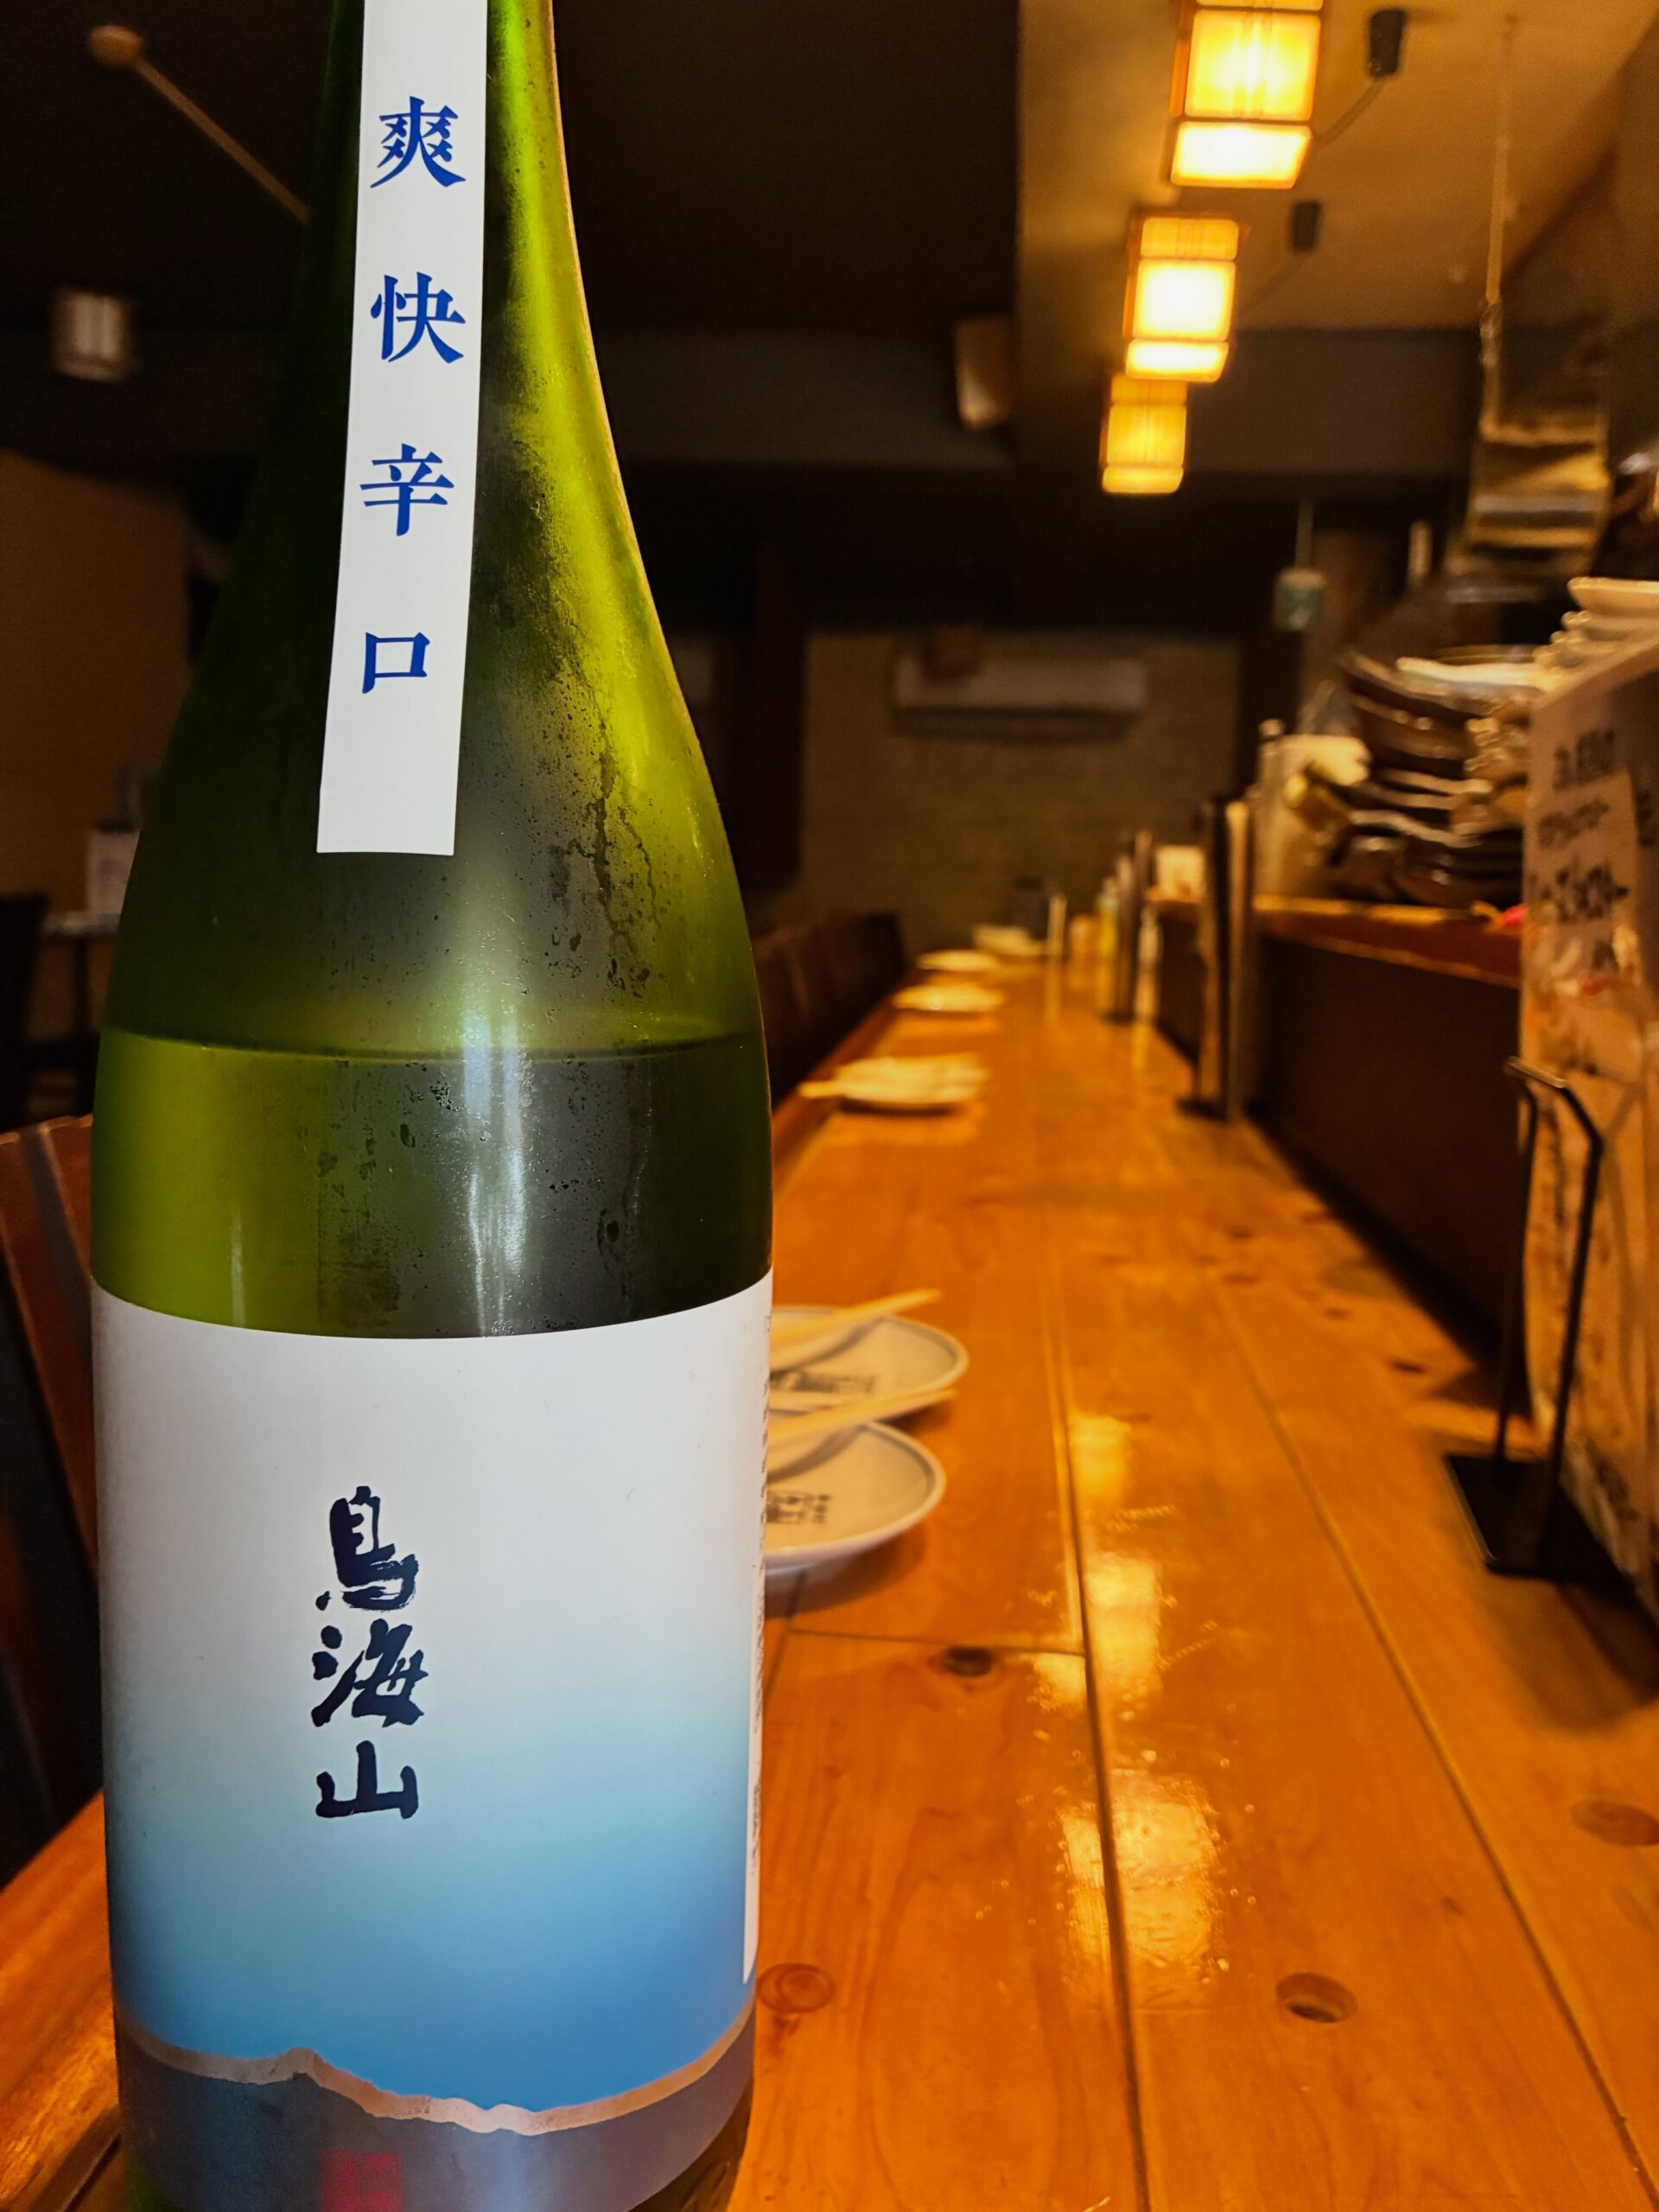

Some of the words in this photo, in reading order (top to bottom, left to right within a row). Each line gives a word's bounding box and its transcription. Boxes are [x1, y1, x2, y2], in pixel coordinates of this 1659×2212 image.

[360, 96, 465, 693] 爽快辛口
[311, 1485, 429, 1820] 鳥海山
